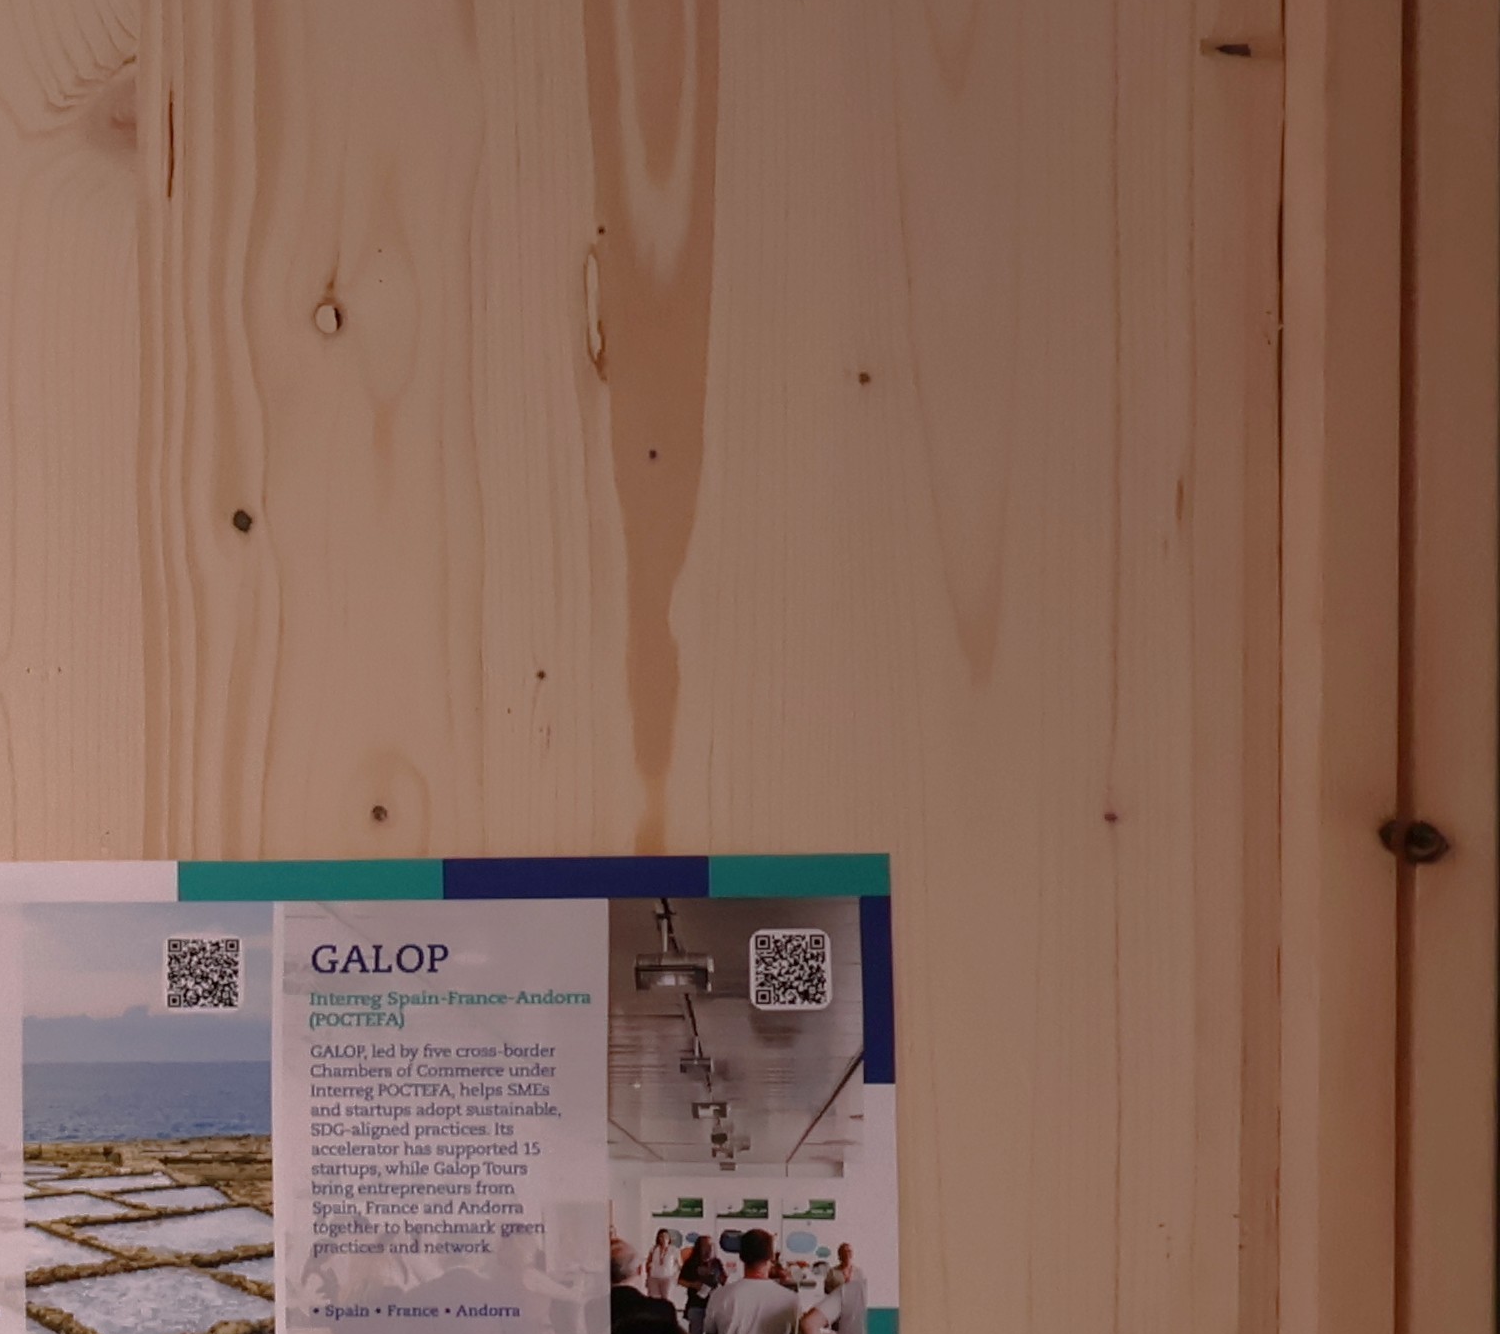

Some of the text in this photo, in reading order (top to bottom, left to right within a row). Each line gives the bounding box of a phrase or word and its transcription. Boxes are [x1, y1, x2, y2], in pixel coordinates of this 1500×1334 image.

[310, 943, 449, 974] GALOP
[325, 1301, 521, 1322] Spain France Andorra
